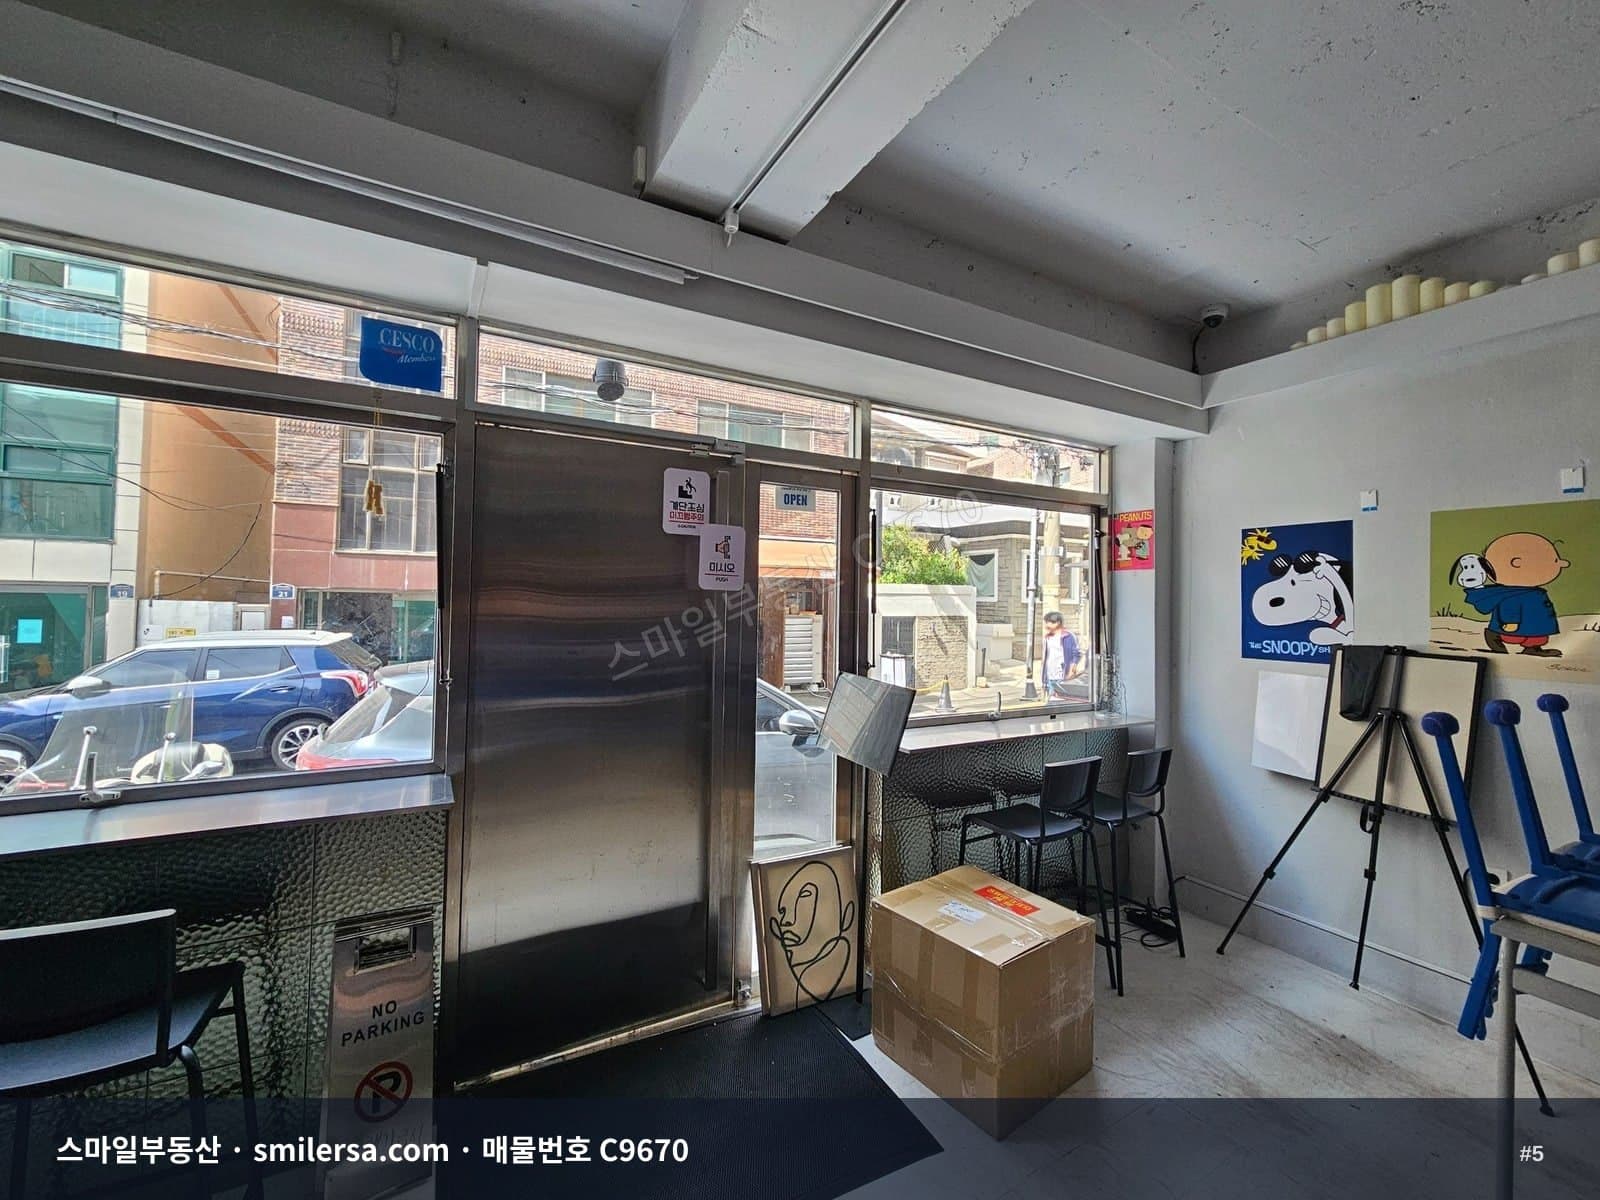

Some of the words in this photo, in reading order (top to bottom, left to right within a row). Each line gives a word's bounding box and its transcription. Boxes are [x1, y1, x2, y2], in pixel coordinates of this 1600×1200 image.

[378, 327, 435, 353] CESCO
[669, 500, 705, 513] 계단조심
[783, 493, 808, 506] OPEN
[1120, 511, 1152, 522] PEANUTS
[708, 561, 736, 573] 미시오
[1262, 640, 1319, 656] SNOOPY
[1318, 646, 1331, 654] SH
[372, 1001, 397, 1019] NO
[341, 1011, 425, 1047] PARKING
